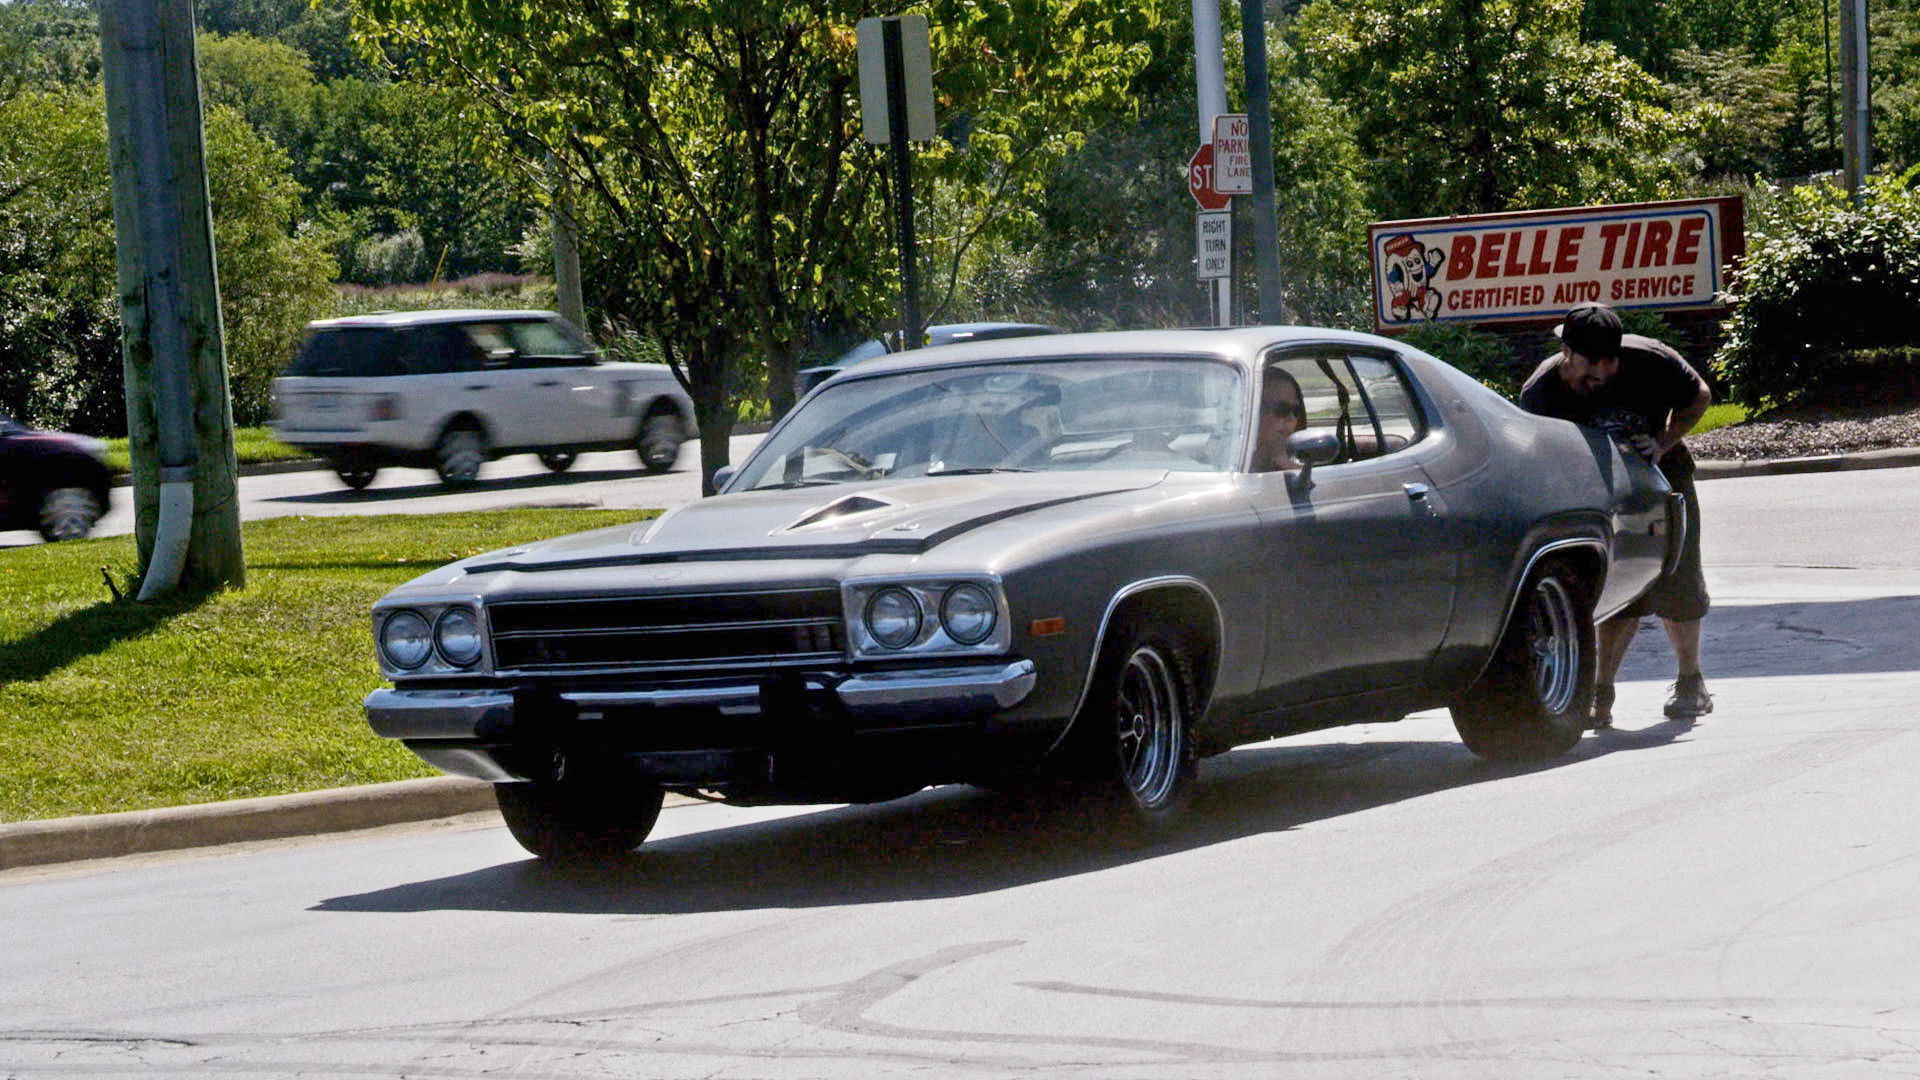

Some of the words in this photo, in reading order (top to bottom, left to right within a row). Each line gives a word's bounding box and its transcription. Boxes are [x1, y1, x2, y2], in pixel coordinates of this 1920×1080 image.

[1231, 122, 1248, 136] NO
[1218, 138, 1248, 153] PARKI
[1193, 164, 1211, 190] ST
[1202, 219, 1226, 233] RIGHT
[1205, 239, 1226, 251] TURN
[1445, 226, 1585, 281] BELLE
[1599, 217, 1706, 271] TIRE
[1205, 257, 1225, 271] ONLY
[1447, 285, 1545, 311] CERTIFIED
[1552, 280, 1601, 305] AUTO
[1611, 274, 1696, 299] SERVICE
